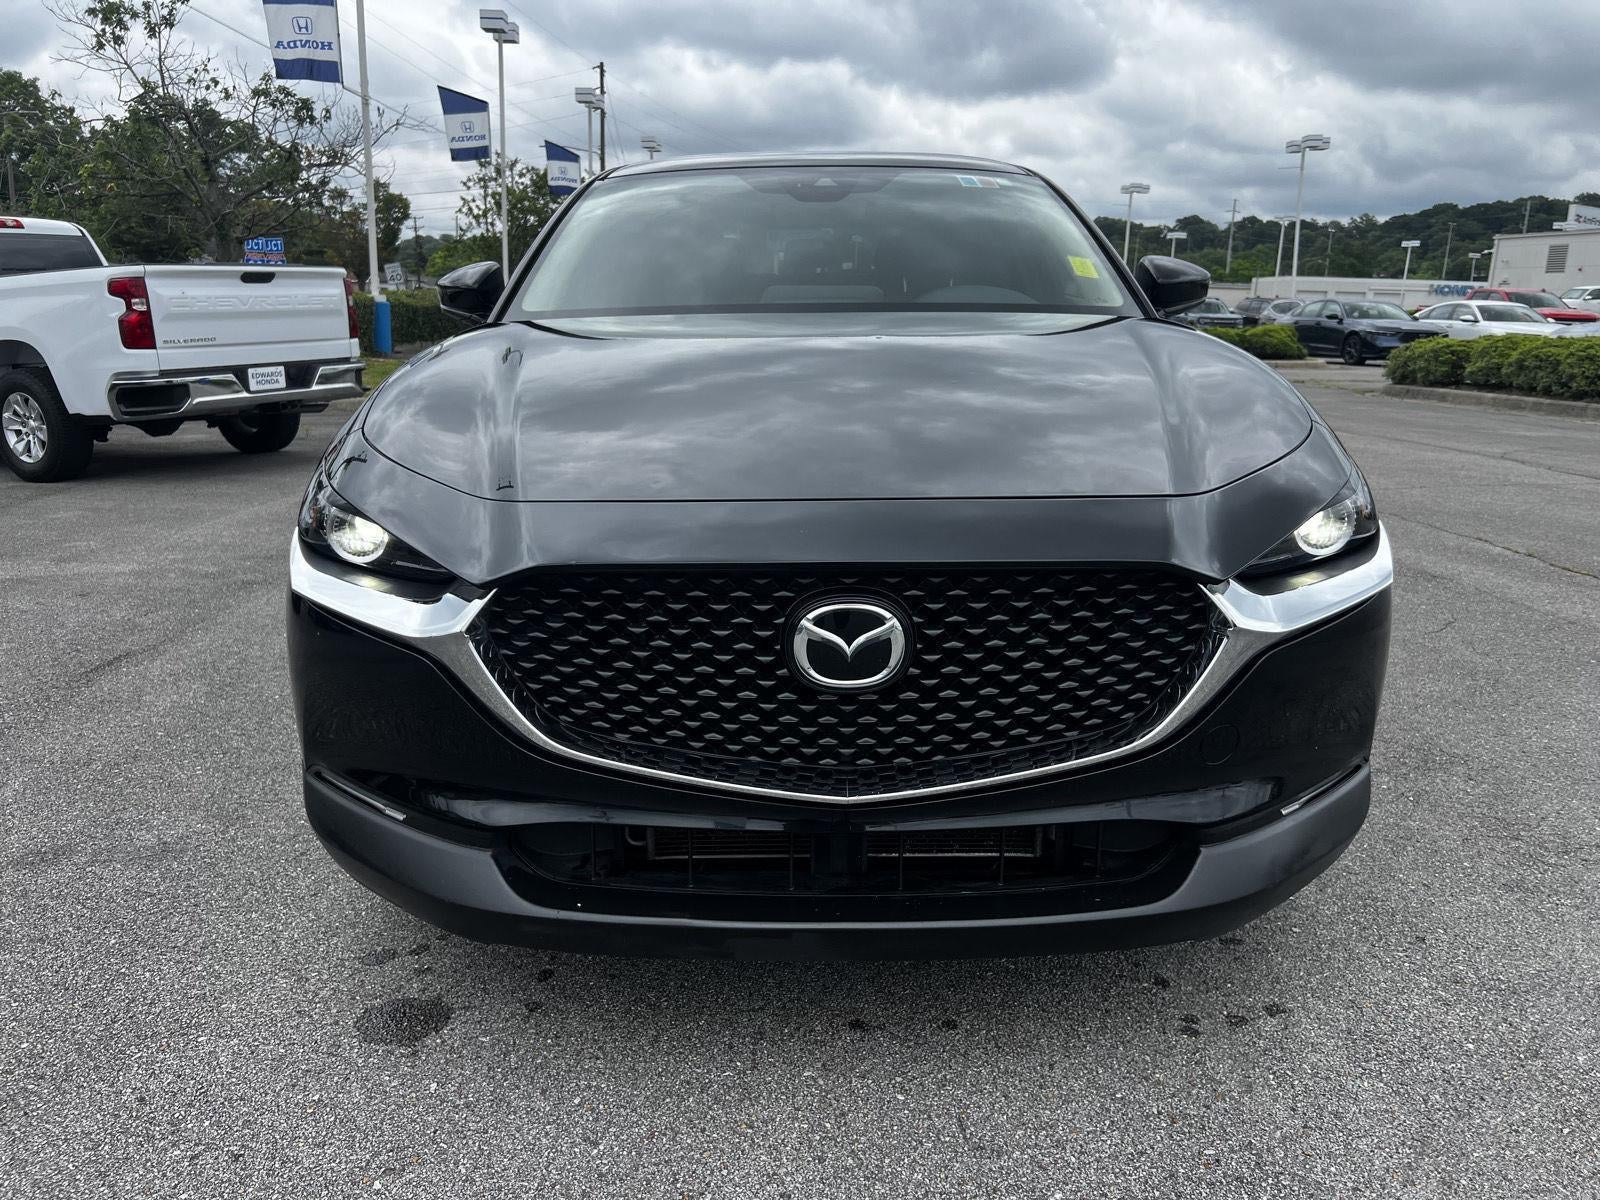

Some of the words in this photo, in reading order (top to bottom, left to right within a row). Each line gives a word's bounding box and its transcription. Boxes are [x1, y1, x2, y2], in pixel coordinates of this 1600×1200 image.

[247, 239, 263, 250] JCT
[266, 240, 282, 251] JCT
[389, 273, 402, 282] 40
[169, 295, 338, 311] CHEVROLET
[162, 336, 217, 345] SILVERADO
[251, 370, 283, 380] EDWARDS
[256, 378, 280, 387] HONDA
